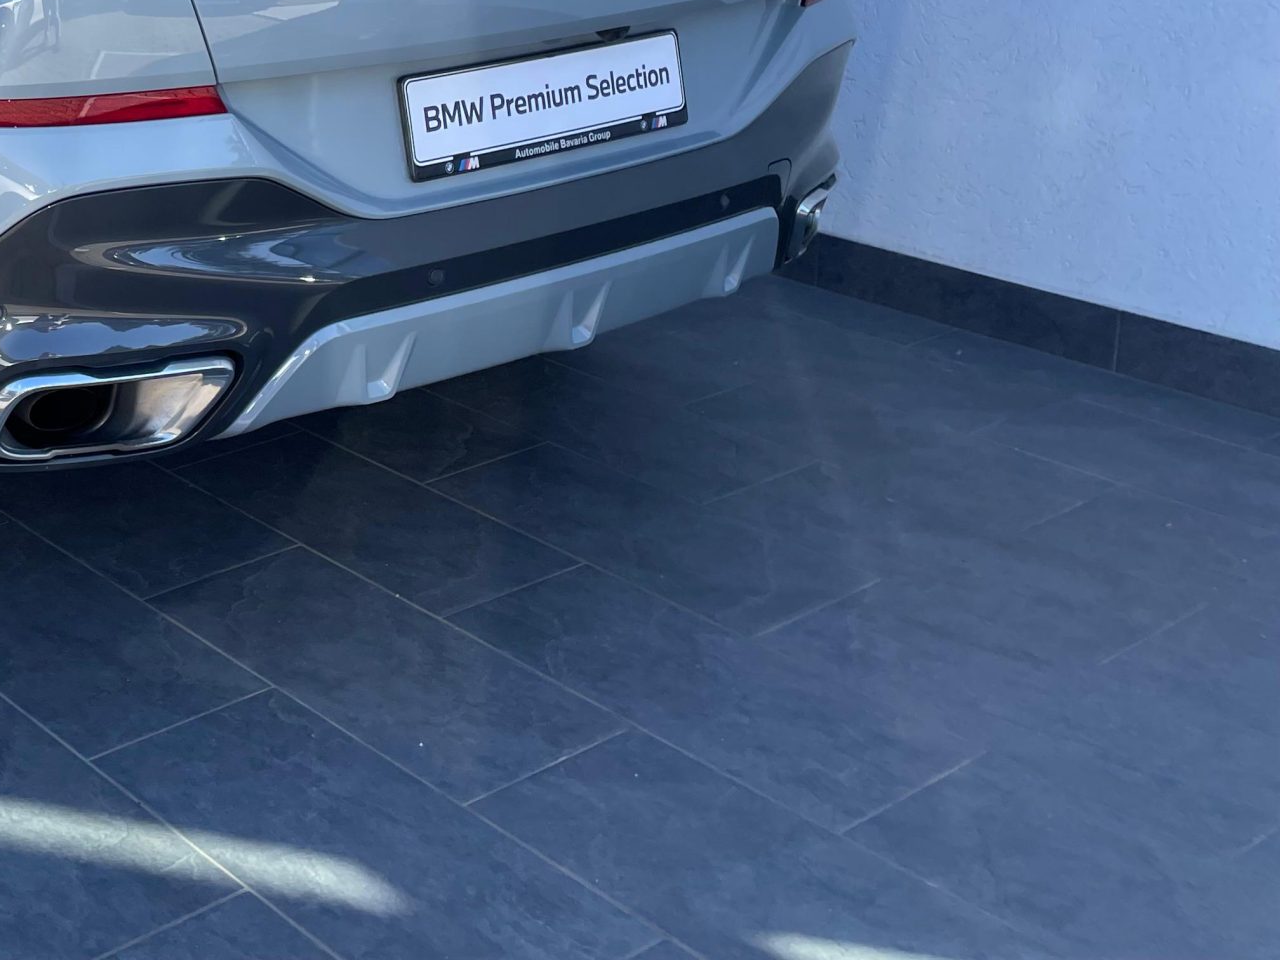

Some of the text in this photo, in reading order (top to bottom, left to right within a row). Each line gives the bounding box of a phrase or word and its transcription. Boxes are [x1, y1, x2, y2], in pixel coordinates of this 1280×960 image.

[423, 64, 670, 133] BMW Premium Selection
[515, 130, 611, 159] Automobile Bavaria Group
